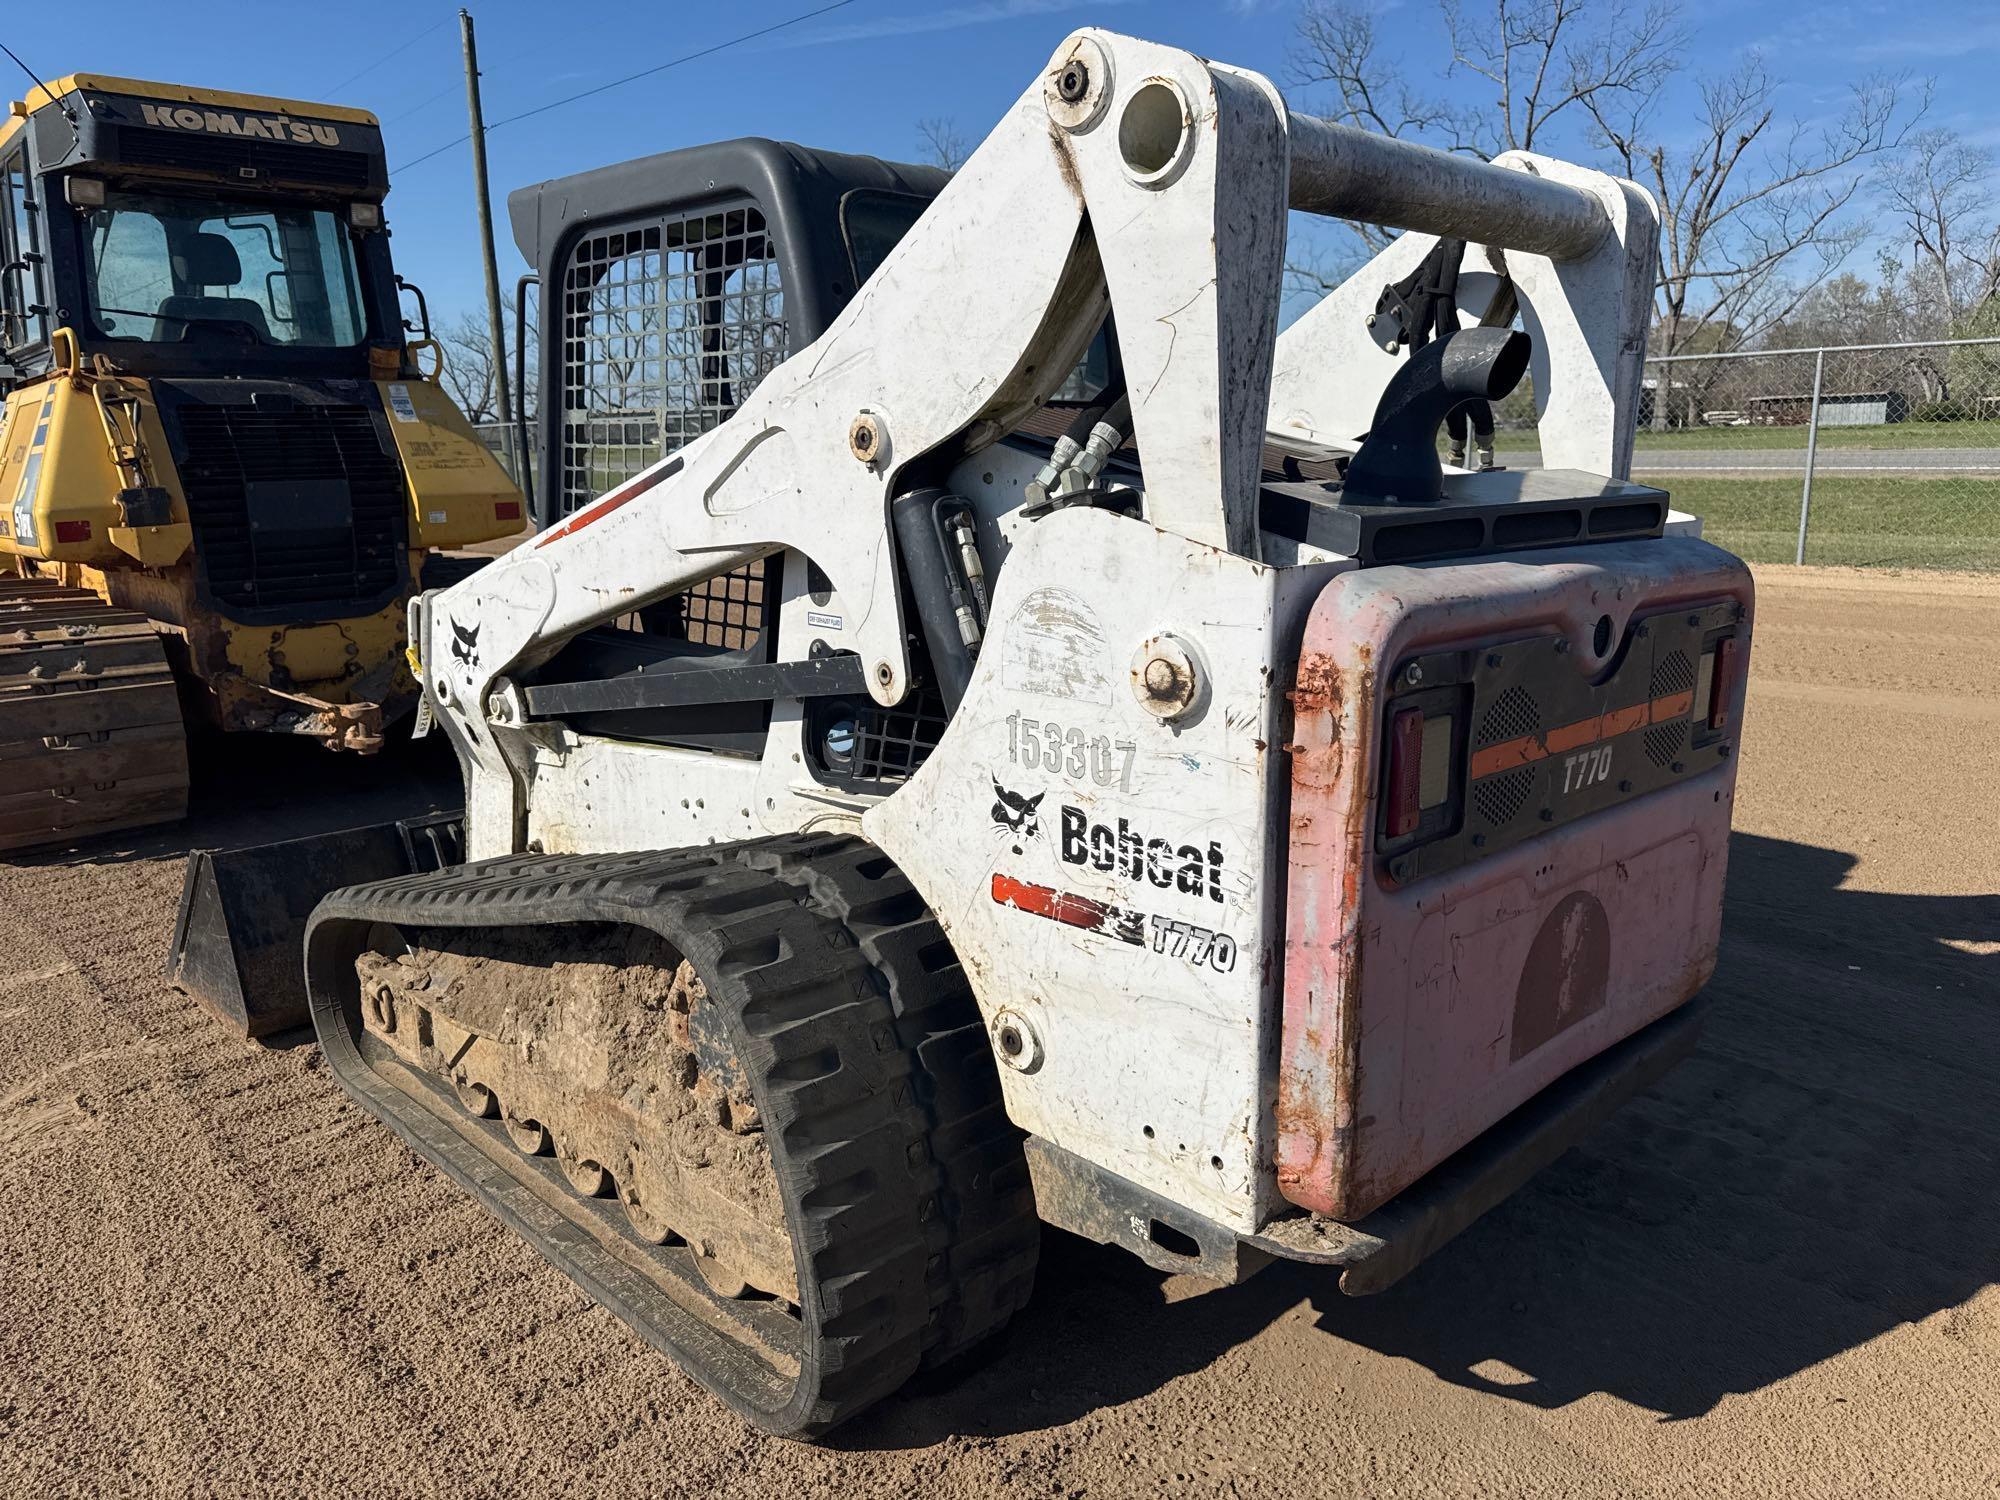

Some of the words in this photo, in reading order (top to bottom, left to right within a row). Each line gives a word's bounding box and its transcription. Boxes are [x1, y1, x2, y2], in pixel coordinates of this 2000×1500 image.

[141, 103, 340, 146] KOMATSU
[1006, 712, 1137, 793] 153307
[1563, 744, 1613, 794] T770
[1061, 803, 1225, 904] Bobcat
[1151, 913, 1238, 974] T770
